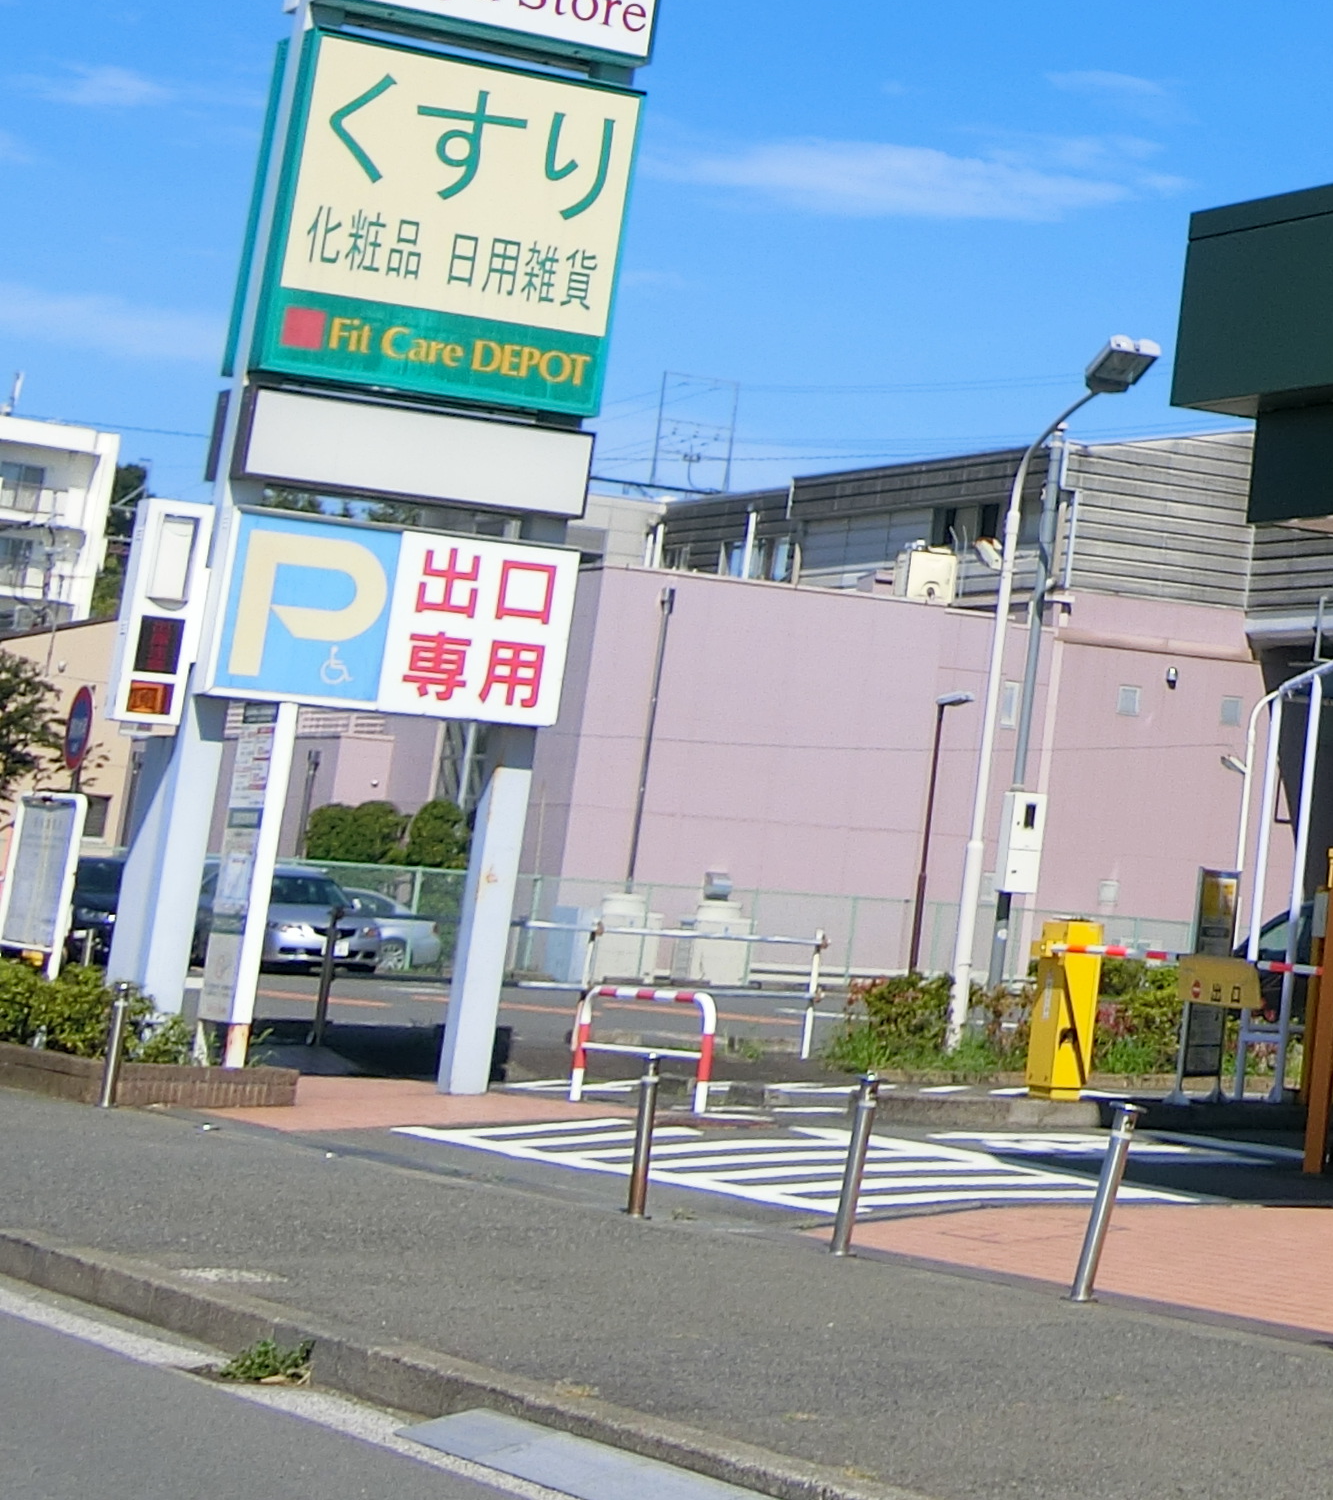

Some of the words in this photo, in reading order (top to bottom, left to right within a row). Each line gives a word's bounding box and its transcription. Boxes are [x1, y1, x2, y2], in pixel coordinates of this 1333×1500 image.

[329, 73, 617, 220] くすり
[307, 204, 422, 281] 化粧品
[446, 233, 598, 310] 日用雑貨
[328, 317, 371, 355] Fit
[380, 326, 464, 368] Care
[471, 339, 591, 387] DEPOT
[227, 528, 388, 677] P
[414, 546, 558, 626] 出口
[401, 631, 546, 709] 専用
[1210, 982, 1242, 1004] 出口
